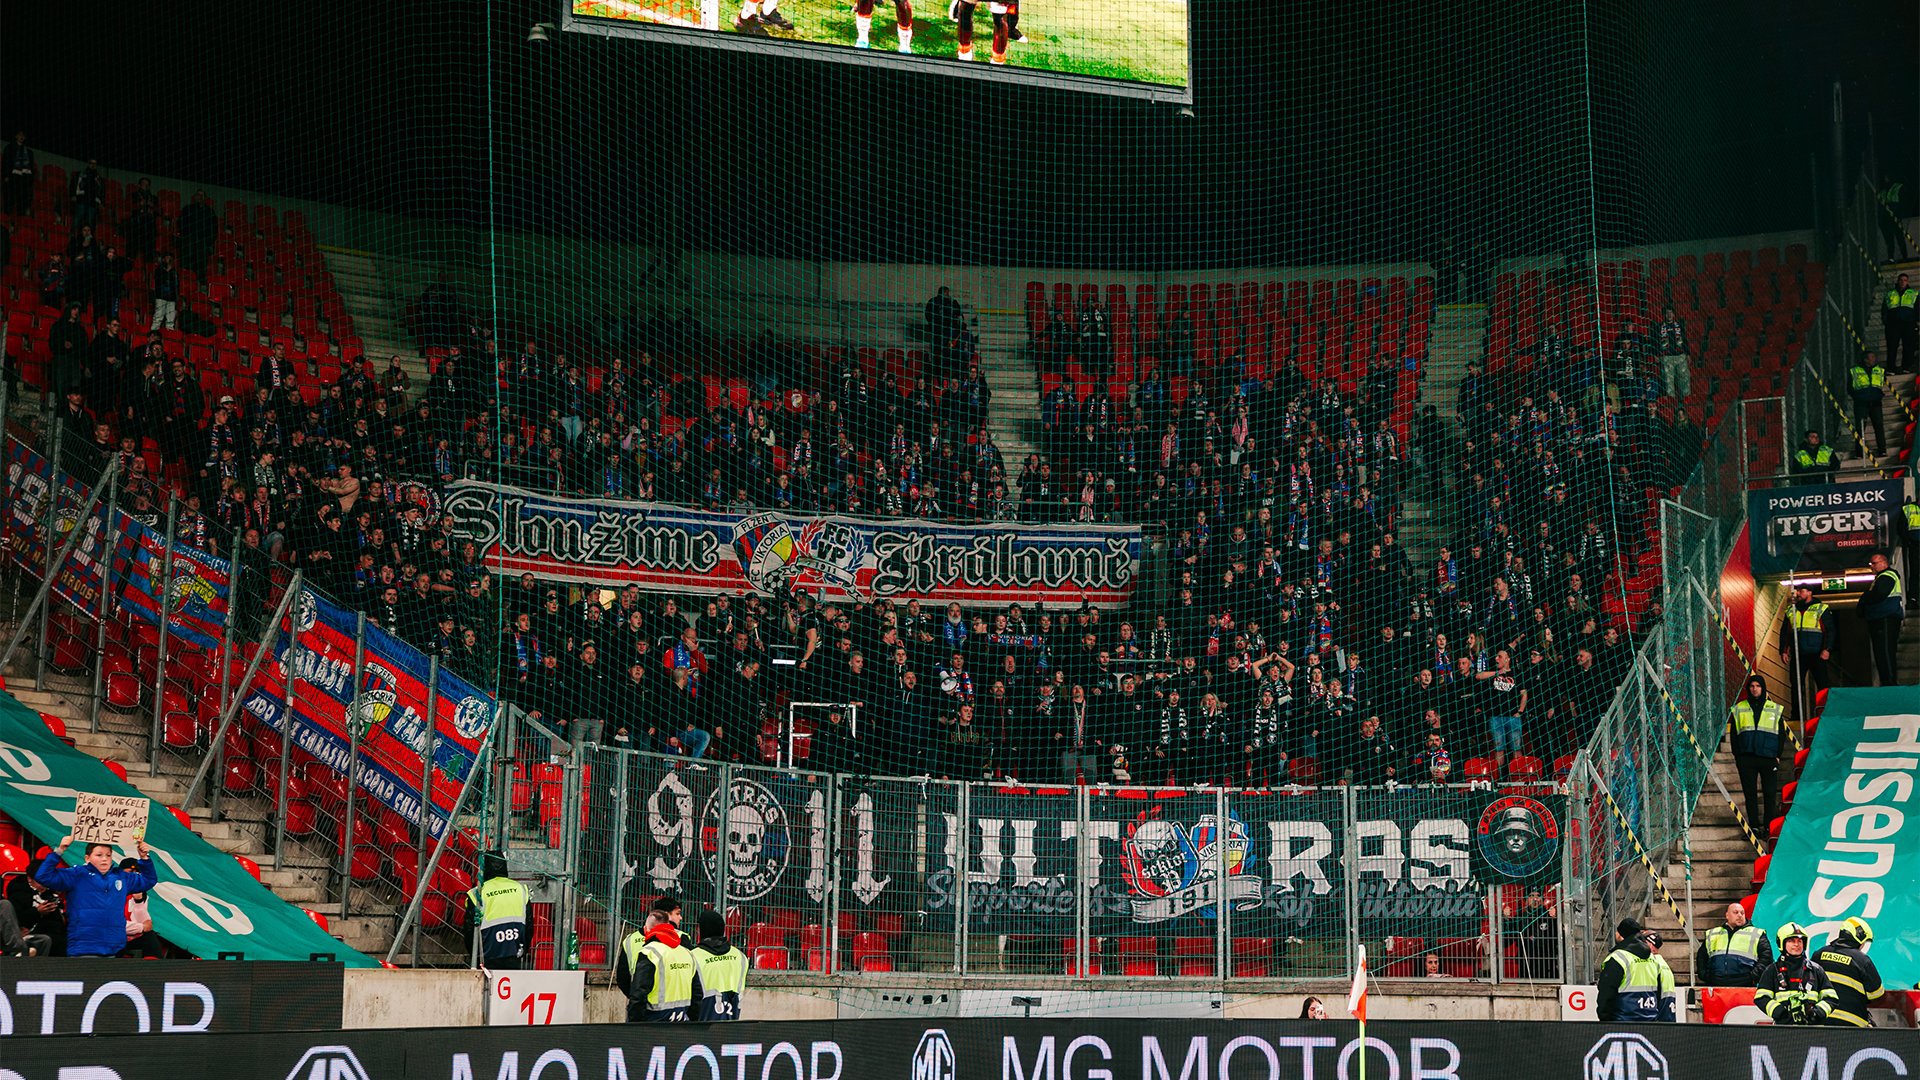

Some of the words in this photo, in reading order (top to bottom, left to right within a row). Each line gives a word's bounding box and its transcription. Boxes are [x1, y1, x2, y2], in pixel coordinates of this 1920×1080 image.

[1769, 495, 1824, 510] POWER
[1828, 493, 1841, 505] IS
[1777, 511, 1875, 536] TIGER
[824, 523, 850, 547] FC
[1837, 539, 1875, 547] ORIGINAL
[753, 527, 788, 564] VIKTORIA
[817, 541, 846, 564] VP
[76, 805, 93, 815] CAN
[106, 807, 129, 818] HAVE
[132, 810, 138, 818] A
[74, 816, 105, 828] JERSEY
[73, 826, 122, 843] PLEASE
[486, 888, 518, 897] SECURITY
[704, 956, 737, 964] SECURITY
[497, 977, 511, 1000] G
[520, 993, 557, 1026] 17
[1568, 991, 1586, 1011] G
[1637, 997, 1656, 1009] 143
[1142, 1035, 1462, 1080] MOTOR
